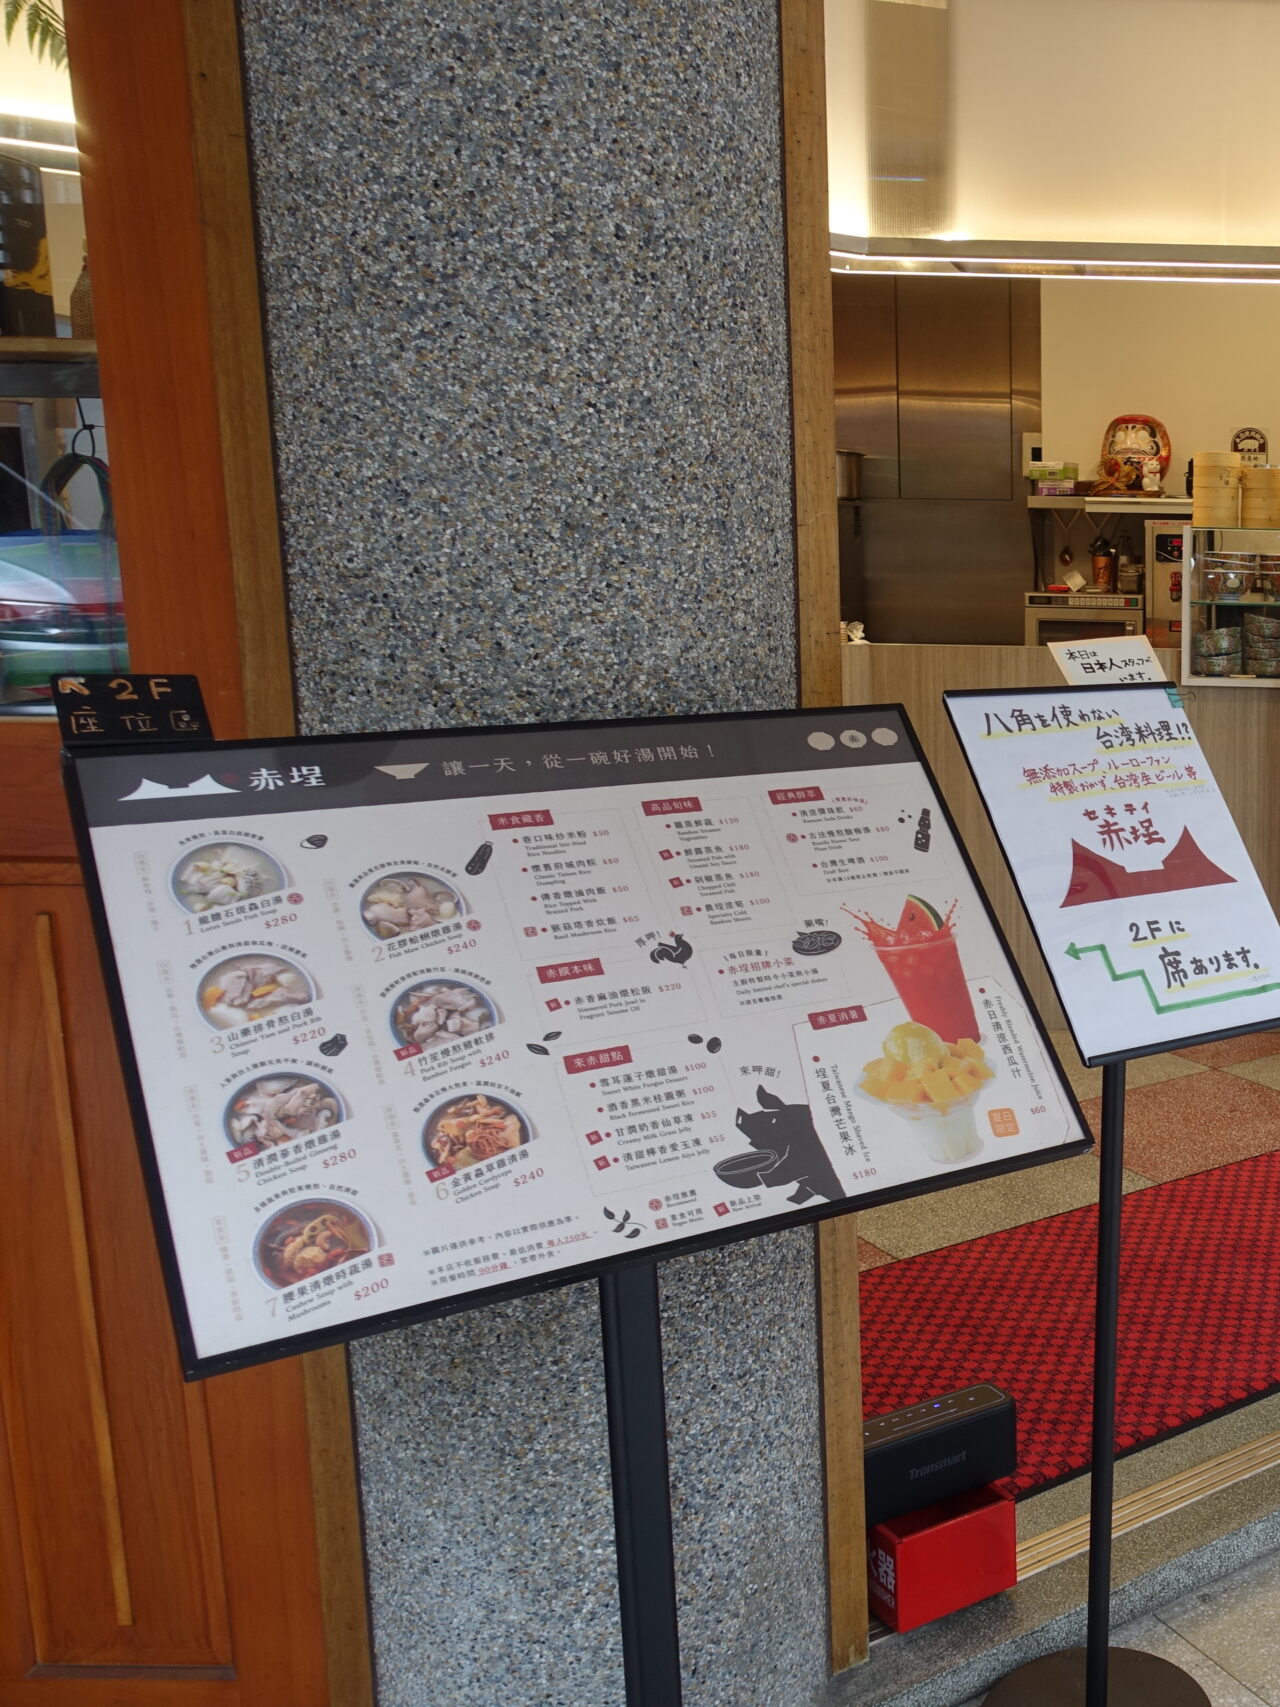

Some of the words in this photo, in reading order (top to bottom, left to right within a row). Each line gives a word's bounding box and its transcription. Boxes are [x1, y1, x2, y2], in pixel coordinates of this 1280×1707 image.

[1066, 649, 1098, 661] 本日は
[984, 704, 1120, 736] 八角を使わない
[248, 764, 327, 792] 赤埕
[1083, 801, 1150, 821] セキテイ
[717, 816, 740, 825] $120
[1097, 818, 1165, 851] 赤埕
[727, 843, 750, 852] $180
[184, 919, 193, 935] 1
[265, 912, 298, 929] $280
[372, 946, 385, 962] 2
[447, 939, 477, 955] $240
[656, 981, 683, 993] $220
[292, 1027, 326, 1045] $220
[210, 1036, 225, 1054] 3
[480, 1050, 510, 1068] $240
[573, 1050, 624, 1068] 來赤甜點
[683, 1061, 707, 1072] $100
[403, 1061, 416, 1077] 4
[691, 1084, 715, 1095] $100
[1031, 1083, 1044, 1100] Juice
[699, 1109, 718, 1120] $55
[829, 1063, 849, 1098] Taiwanese
[843, 1099, 858, 1124] Mango
[852, 1123, 869, 1151] Shaved
[1029, 1105, 1046, 1115] $60
[707, 1133, 726, 1144] $55
[322, 1148, 357, 1169] $280
[236, 1164, 250, 1183] 5
[513, 1167, 545, 1187] $240
[851, 1166, 878, 1180] $180
[435, 1182, 449, 1201] 6
[353, 1278, 390, 1301] $200
[265, 1296, 278, 1318] 7
[909, 1450, 967, 1480] Tronsmart
